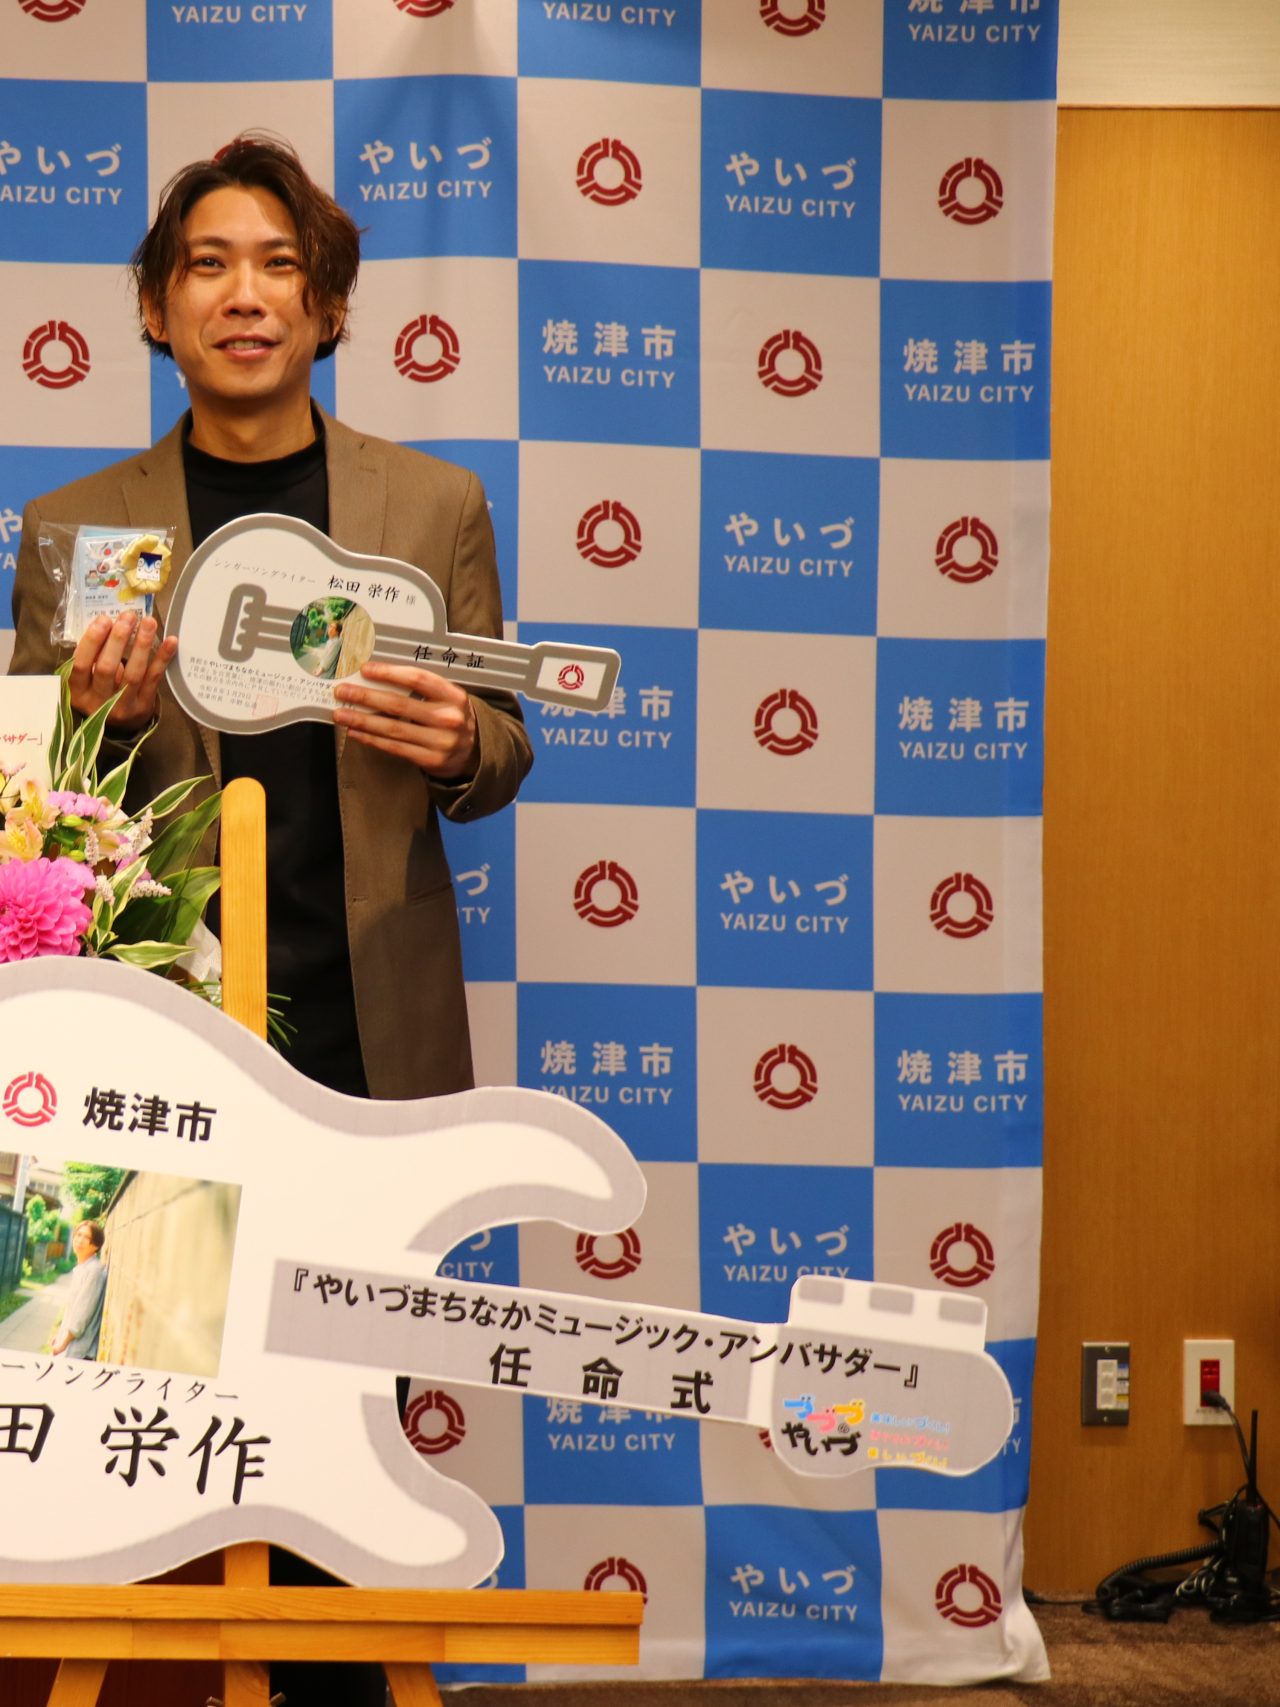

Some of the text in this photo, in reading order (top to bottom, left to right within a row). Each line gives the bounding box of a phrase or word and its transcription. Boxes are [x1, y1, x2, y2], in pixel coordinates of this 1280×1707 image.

[171, 4, 308, 23] YAIZU CITY
[543, 2, 676, 26] YAIZU CITY
[908, 24, 1040, 42] YAIZU CITY
[359, 138, 492, 175] やいづ
[725, 152, 856, 190] やいづ
[66, 187, 122, 205] CITY
[359, 181, 492, 202] YAIZU CITY
[725, 195, 856, 219] YAIZU CITY
[542, 320, 676, 360] 焼津市
[903, 339, 1036, 375] 焼津市
[543, 366, 675, 389] YAIZU CITY
[904, 384, 1035, 403] YAIZU CITY
[724, 512, 855, 550] やいづ
[724, 554, 854, 578] YAIZU CITY
[327, 574, 360, 594] 松田
[367, 582, 401, 603] 栄作
[414, 643, 485, 670] 任命証
[898, 696, 1029, 733] 焼津市
[541, 728, 672, 749] YAIZU CITY
[899, 742, 1027, 760] YAIZU CITY
[720, 871, 849, 907] やいづ
[720, 912, 849, 934] YAIZU CITY
[540, 1040, 674, 1078] 焼津市
[897, 1050, 1028, 1086] 焼津市
[618, 1087, 672, 1105] CITY
[898, 1095, 1027, 1113] YAIZU CITY
[82, 1086, 218, 1143] 焼津市
[723, 1223, 849, 1257] やいづ
[441, 1261, 494, 1279] CITY
[723, 1265, 788, 1282] YAIZU
[547, 1432, 676, 1451] YAIZU CITY
[781, 1421, 862, 1456] やいづ
[100, 1404, 272, 1506] 栄作
[730, 1564, 857, 1597] やいづ
[729, 1602, 858, 1622] YAIZU CITY
